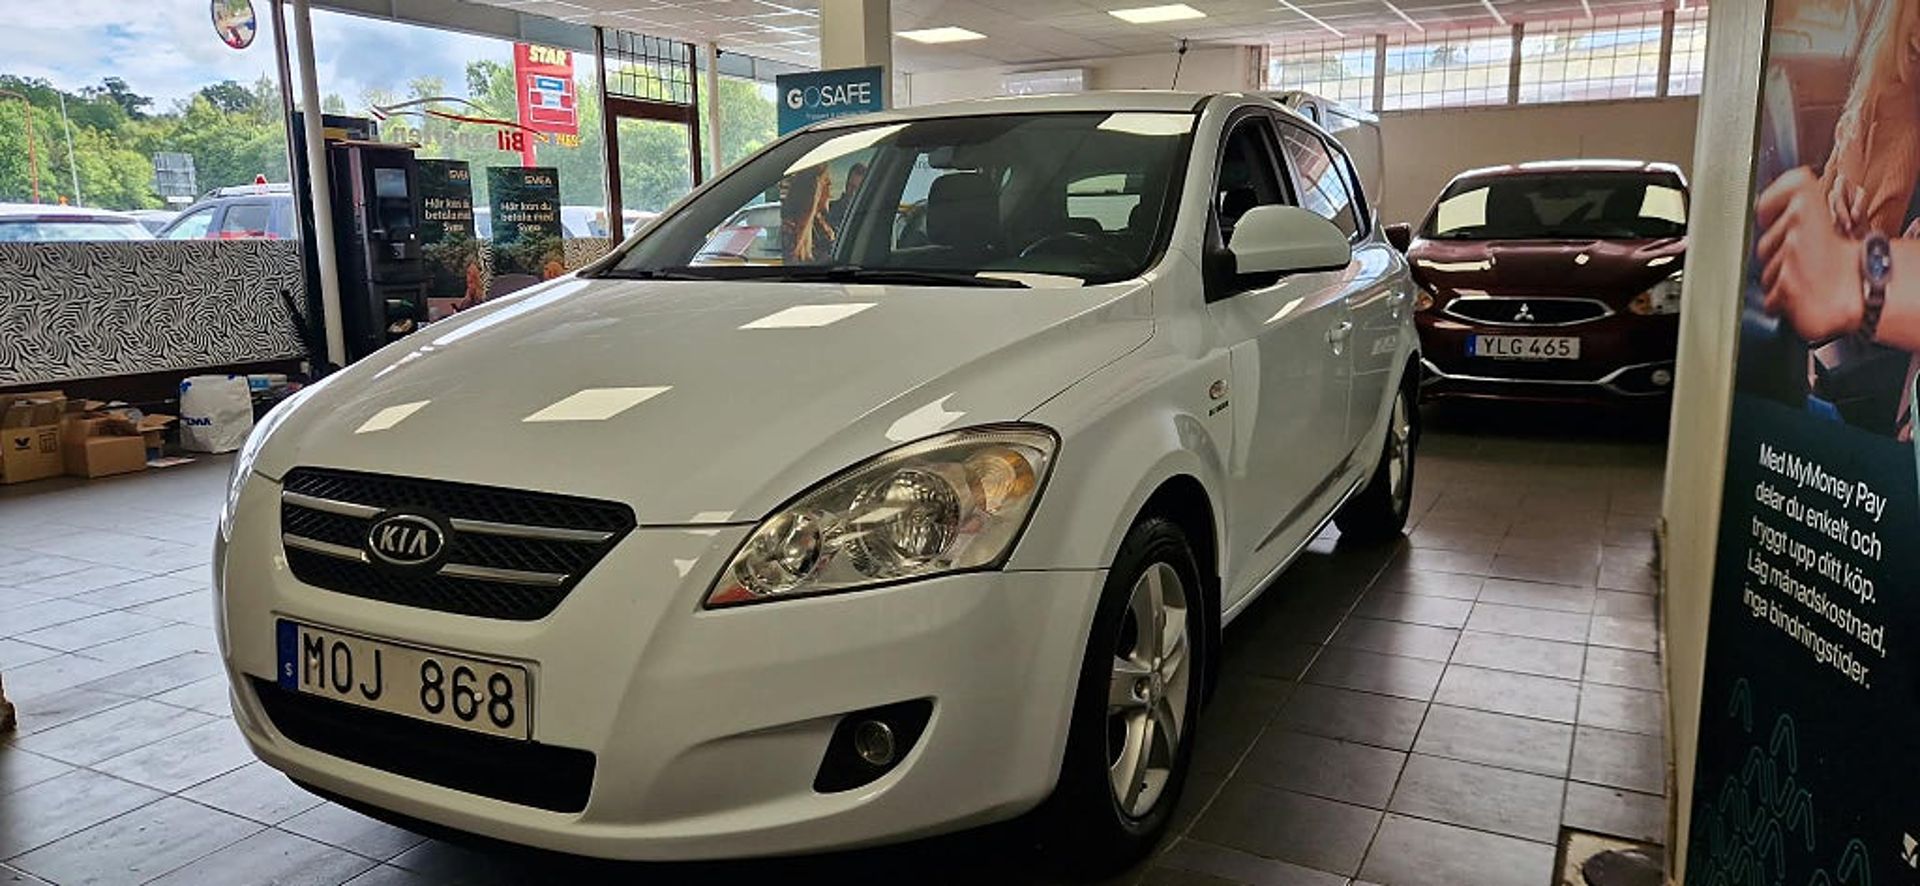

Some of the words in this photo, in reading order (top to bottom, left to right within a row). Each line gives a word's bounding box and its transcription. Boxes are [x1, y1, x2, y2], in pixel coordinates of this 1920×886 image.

[528, 45, 568, 66] STAR
[787, 82, 871, 109] GOSAFE
[524, 175, 552, 185] SVEA
[501, 201, 519, 211] Här
[520, 202, 539, 211] kan
[540, 202, 552, 211] du
[501, 212, 532, 222] betala
[1484, 338, 1523, 355] YLG
[1529, 339, 1570, 356] 465
[1759, 442, 1786, 474] Med
[1786, 454, 1855, 508] MyMoney
[1856, 481, 1888, 523] Pay
[1755, 480, 1786, 512] delar
[1786, 495, 1805, 522] du
[1806, 508, 1849, 545] enkelt
[1851, 529, 1882, 561] och
[380, 525, 427, 555] KIA
[1752, 515, 1788, 556] tryggt
[1788, 539, 1816, 571] upp
[1818, 551, 1842, 584] ditt
[1843, 563, 1876, 604] köp.
[1747, 548, 1769, 585] Låg
[1770, 567, 1886, 658] månadskostnad,
[1743, 581, 1768, 617] inga
[1769, 600, 1871, 690] bindningstider.
[284, 662, 293, 677] S
[303, 632, 383, 701] MOJ
[420, 658, 515, 729] 868
